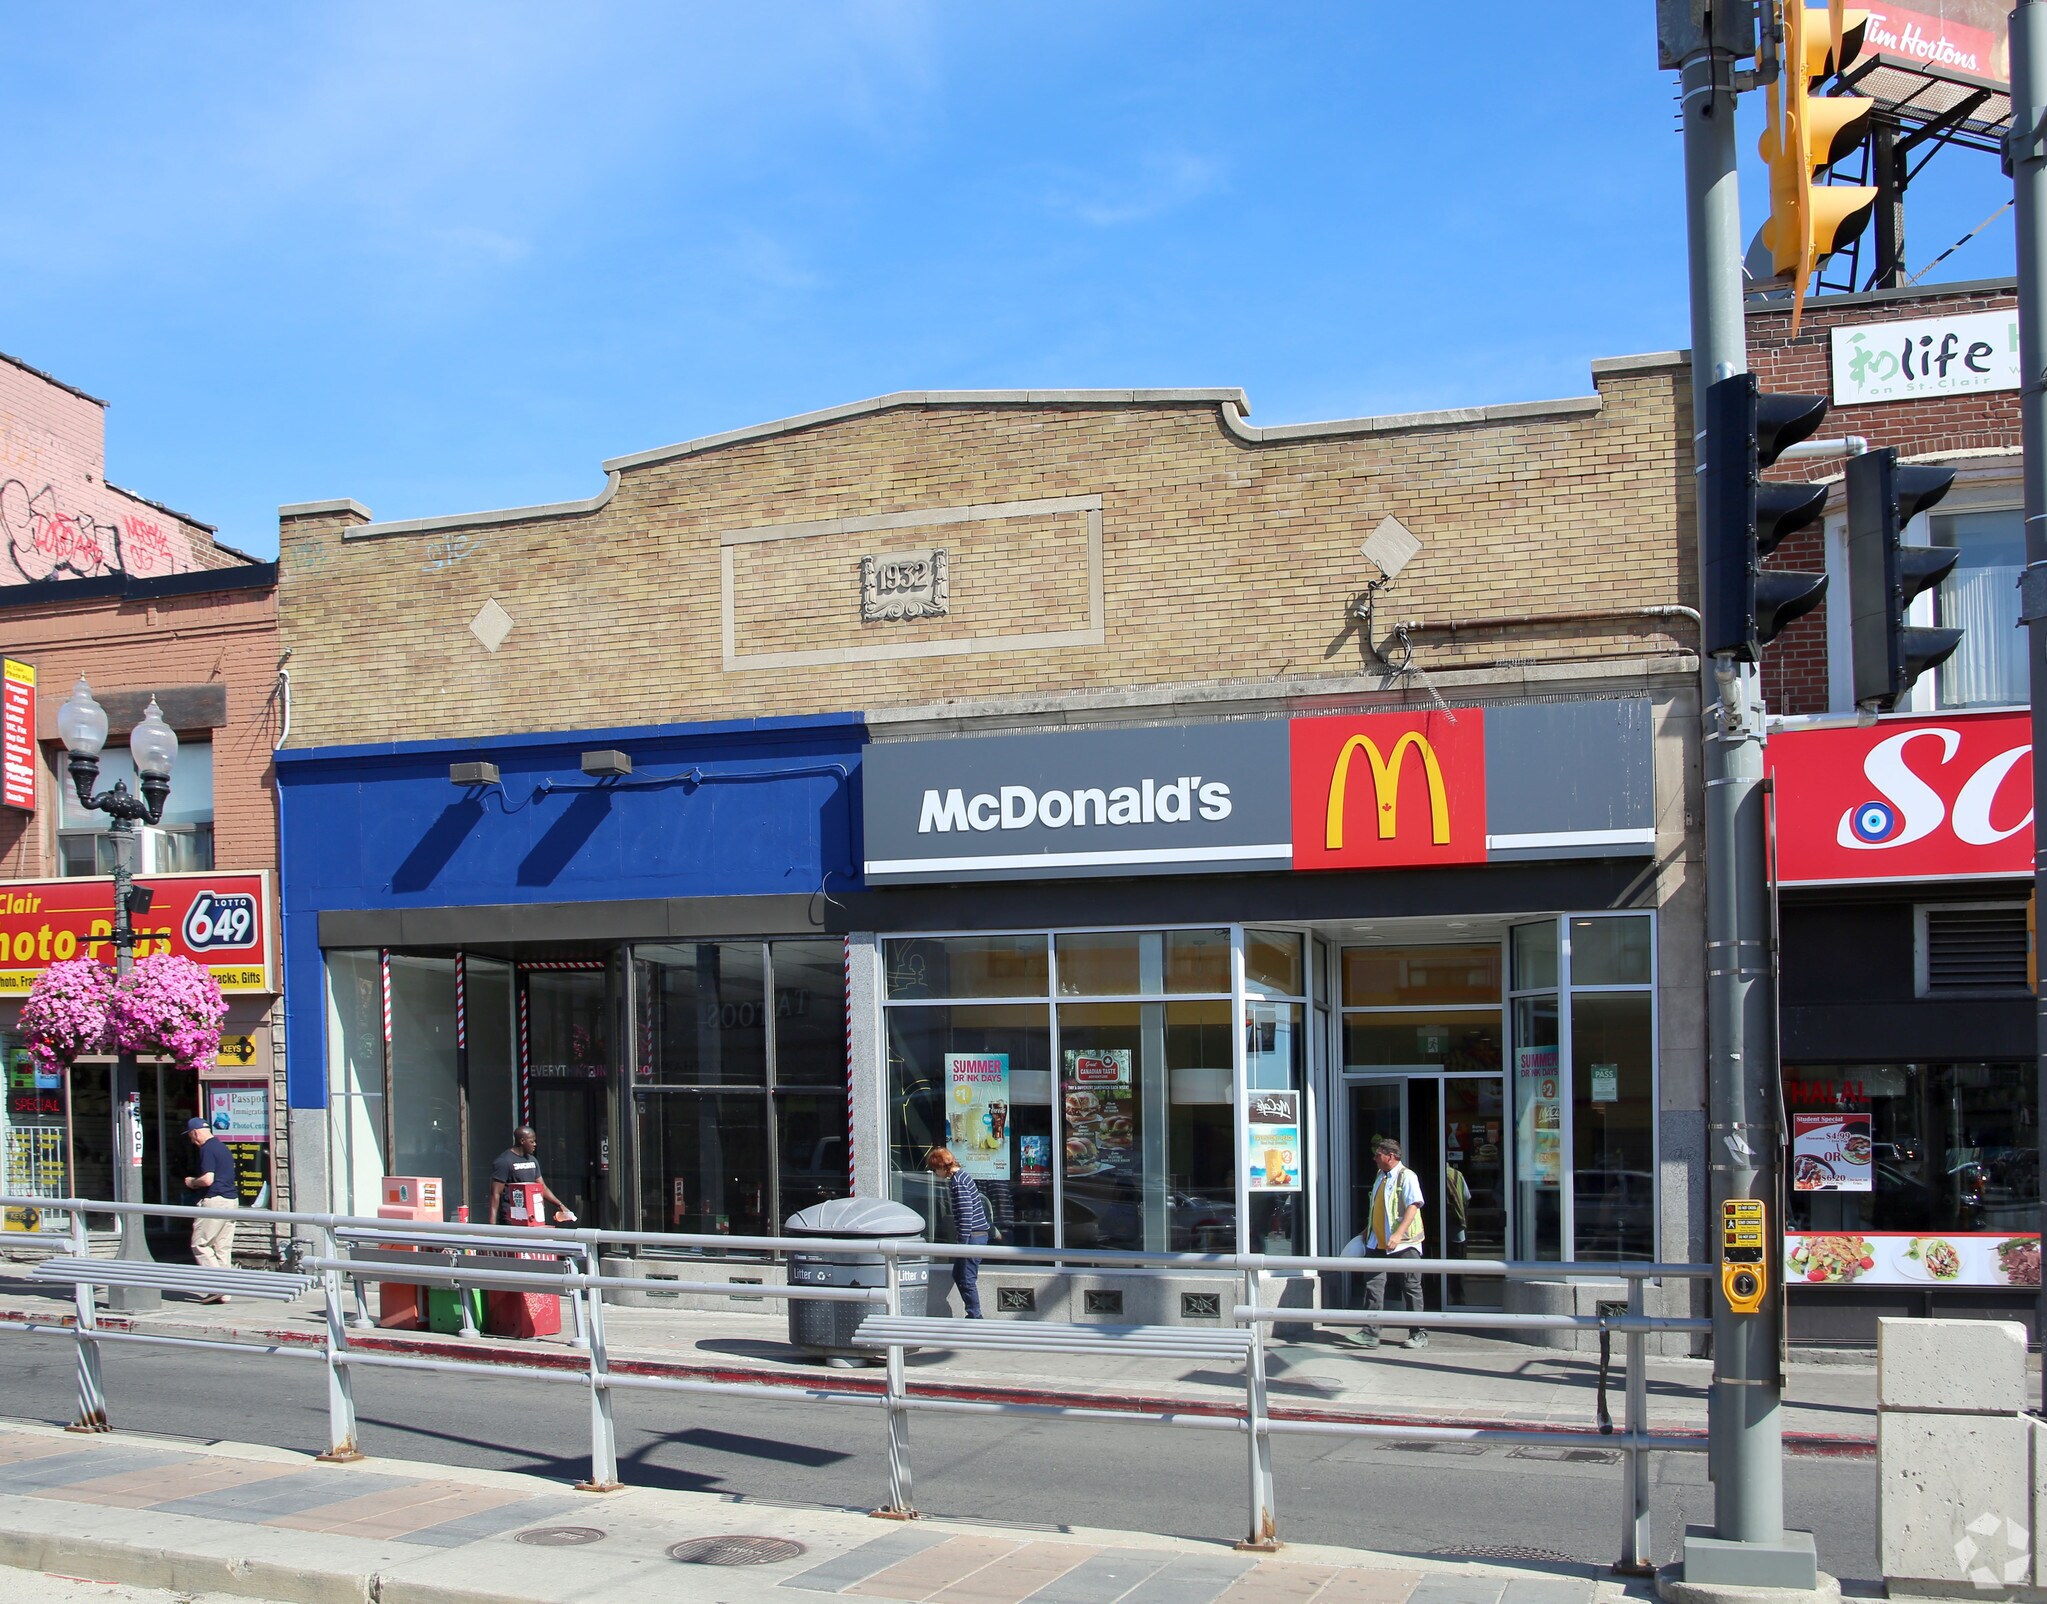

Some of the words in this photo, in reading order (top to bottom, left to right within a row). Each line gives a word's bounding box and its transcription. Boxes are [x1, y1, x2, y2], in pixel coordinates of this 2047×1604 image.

[1863, 13, 1897, 50] Tim
[1902, 332, 1994, 382] life
[1870, 386, 1893, 395] on
[877, 560, 928, 590] 1932
[917, 775, 1233, 834] McDonald's
[215, 898, 248, 907] LOTTO
[88, 918, 172, 959] Pus
[241, 972, 261, 984] Gifts
[223, 1044, 242, 1054] KEYS
[953, 1059, 1002, 1074] SUMMER
[1521, 1052, 1557, 1069] SUMMER
[981, 1073, 1002, 1082] DAYS
[1542, 1067, 1559, 1077] DAYS
[1595, 1070, 1614, 1078] PASS
[1543, 1083, 1554, 1097] $2
[1791, 1080, 1872, 1105] HALAL
[14, 1098, 61, 1112] SPECIAL
[1821, 1115, 1843, 1123] Special
[1826, 1132, 1851, 1140] $4.99
[1824, 1151, 1841, 1162] OR
[1821, 1174, 1846, 1182] $6.20
[793, 1267, 812, 1280] Litter
[897, 1269, 918, 1281] Litter
